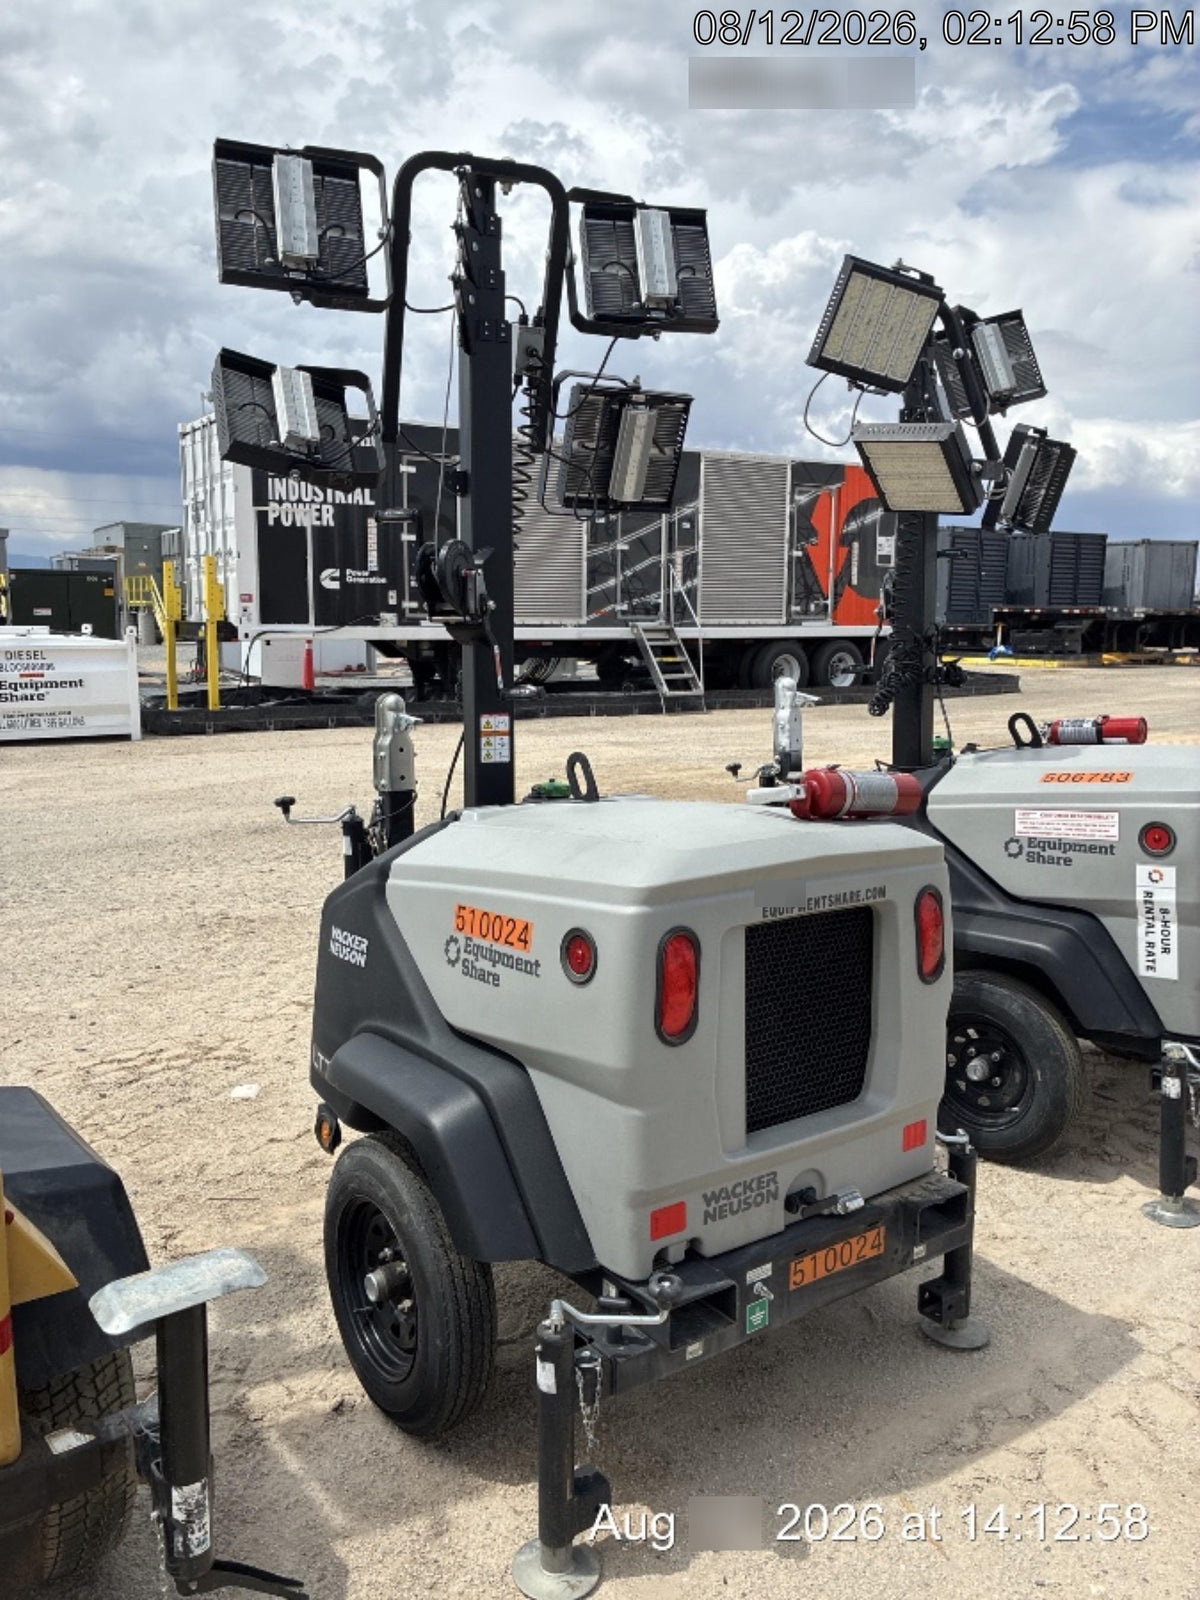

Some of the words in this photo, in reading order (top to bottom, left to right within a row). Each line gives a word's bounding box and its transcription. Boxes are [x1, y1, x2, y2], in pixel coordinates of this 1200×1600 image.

[268, 501, 335, 527] POWER
[5, 650, 47, 661] DIESEL
[0, 679, 84, 692] Equipment
[1042, 771, 1131, 784] 506783
[1026, 850, 1073, 867] Share
[1027, 836, 1116, 856] Equipment
[455, 905, 530, 949] 510024
[1143, 890, 1155, 936] RENTAL
[331, 925, 369, 948] WACKER
[1158, 907, 1171, 955] 8-HOUR
[329, 941, 367, 968] NEUSON
[463, 937, 542, 978] Equipment
[1145, 940, 1156, 973] RATE
[461, 960, 501, 988] Share
[702, 1171, 779, 1207] WACKER
[703, 1186, 779, 1226] NEUSON
[792, 1228, 884, 1288] 510024
